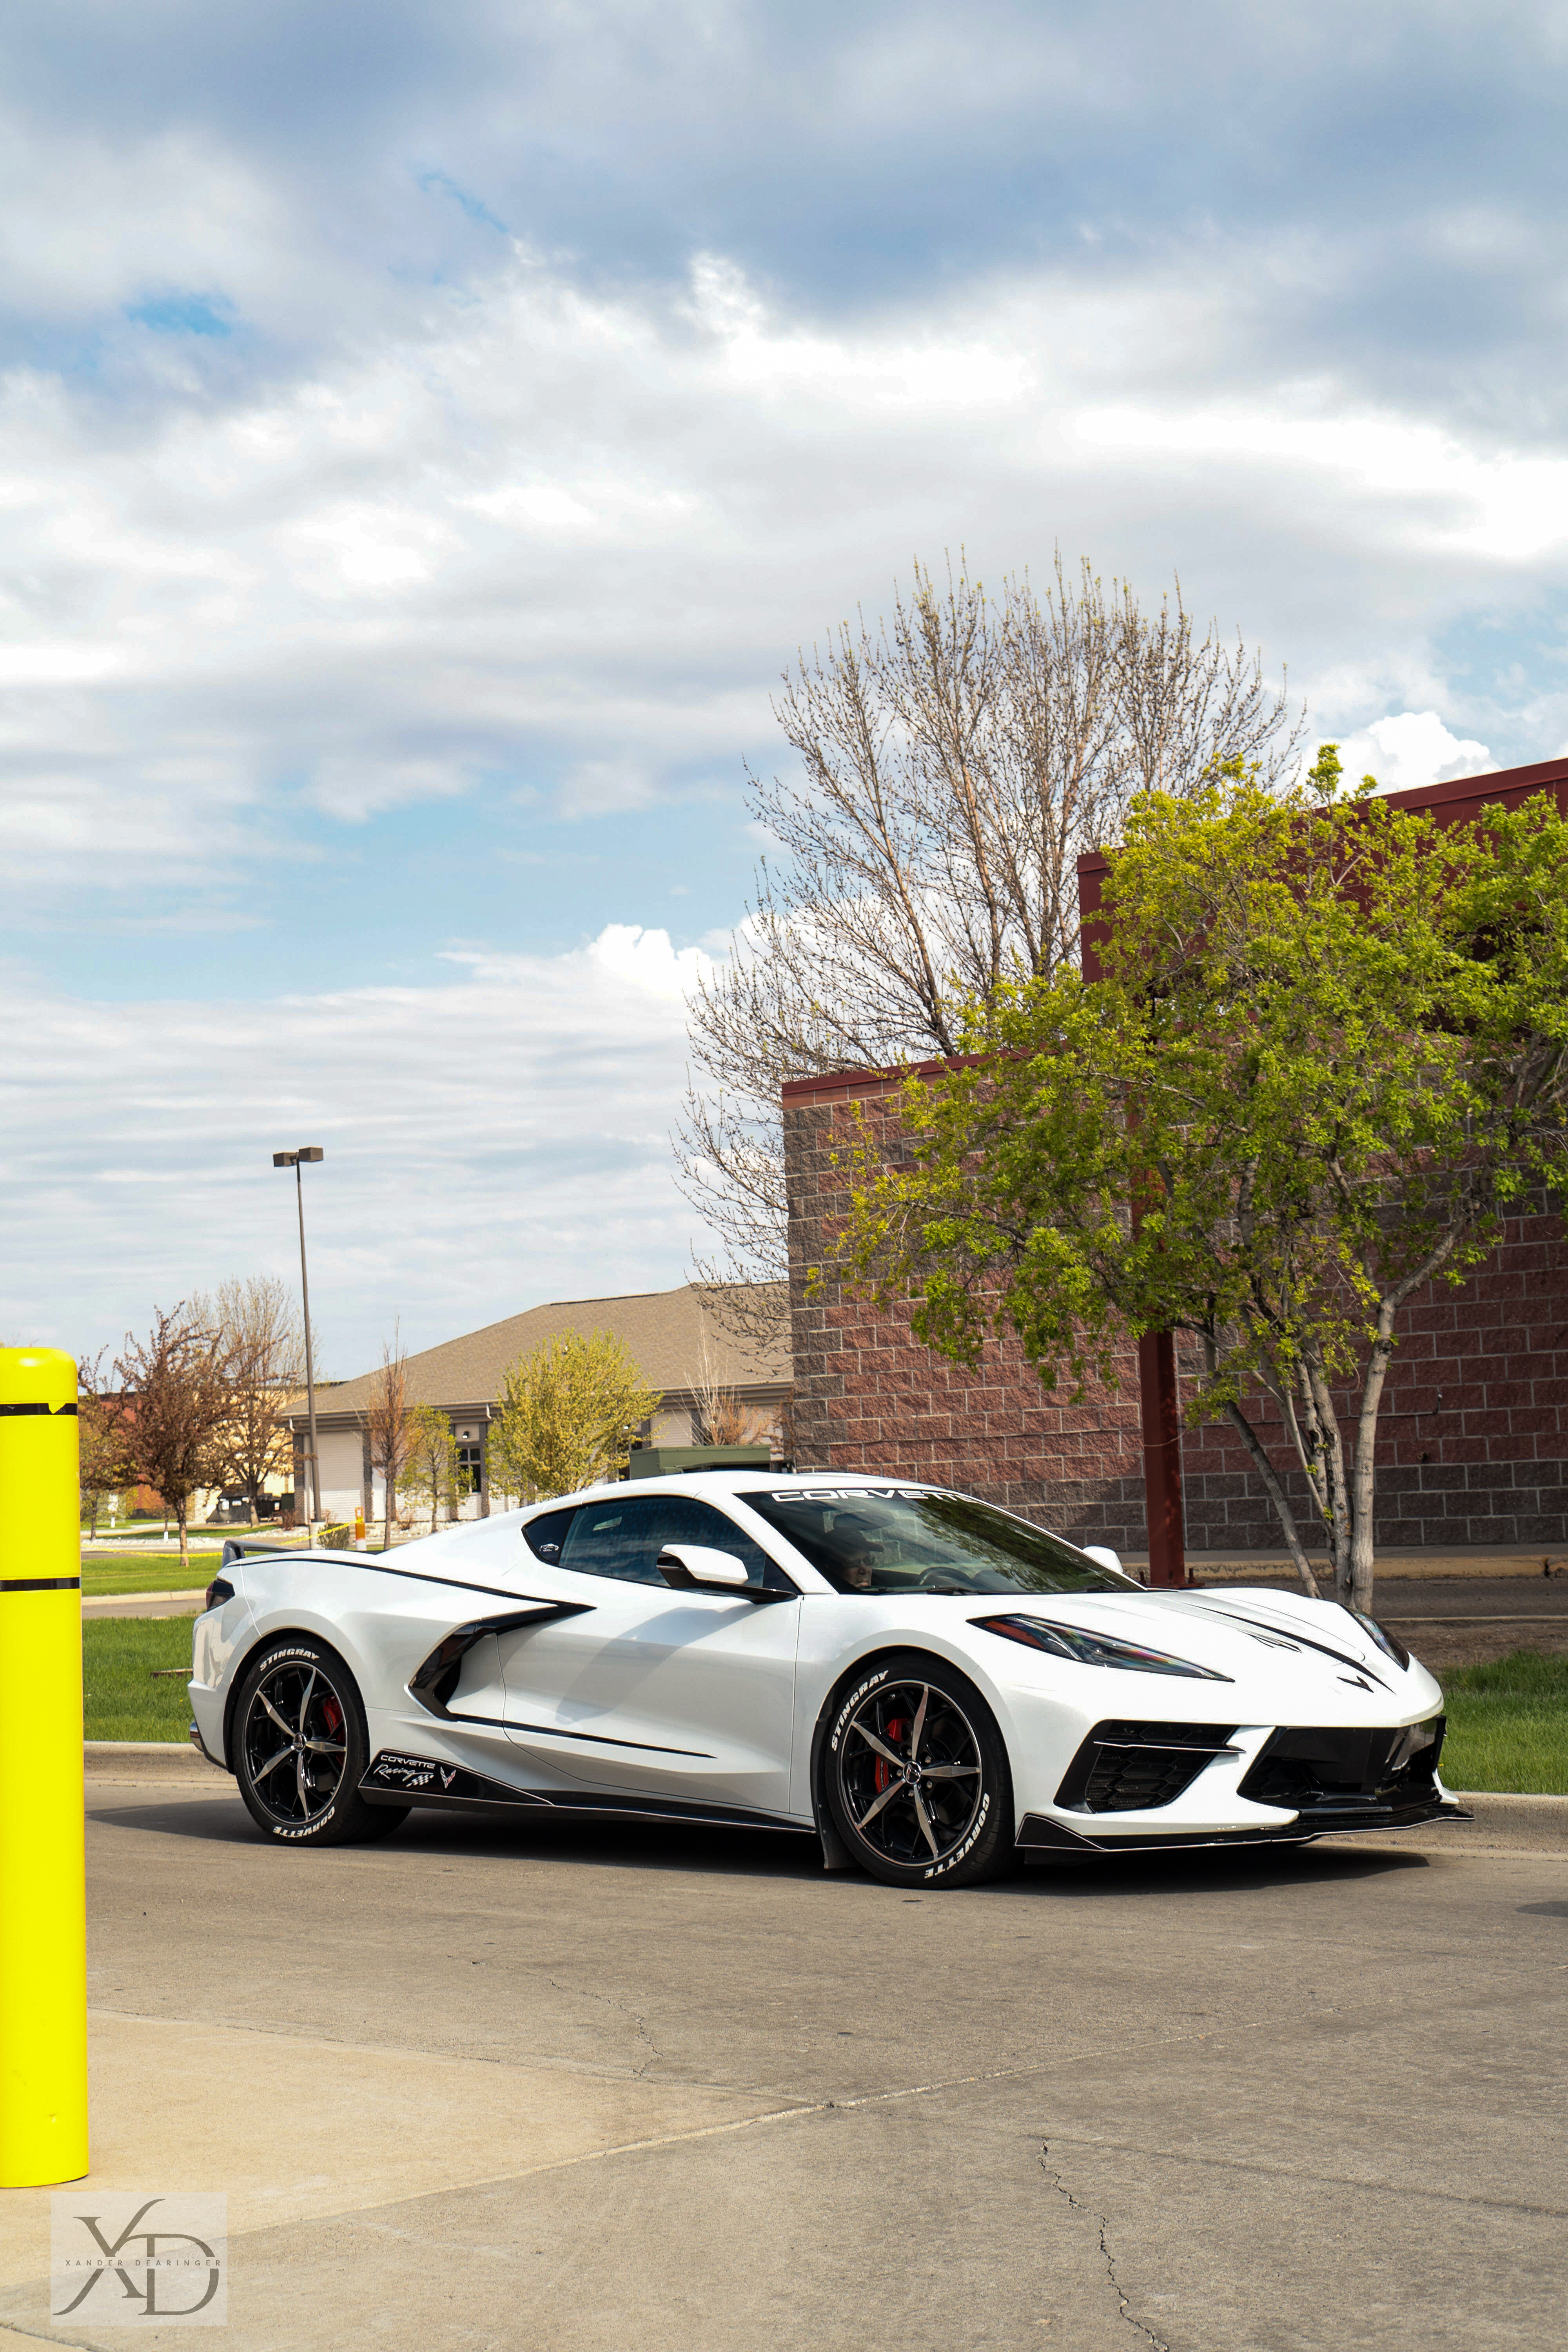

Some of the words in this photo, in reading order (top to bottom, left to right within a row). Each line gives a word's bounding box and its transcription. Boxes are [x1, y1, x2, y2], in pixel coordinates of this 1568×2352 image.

[771, 1489, 978, 1503] CORVETTE
[260, 1648, 319, 1671] STINGRAY
[831, 1670, 889, 1751] STINGRAY
[373, 1763, 434, 1782] Racing
[381, 1755, 436, 1769] CORVETTE
[273, 1806, 335, 1838] CORVETTE
[924, 1793, 990, 1878] CORVETTE
